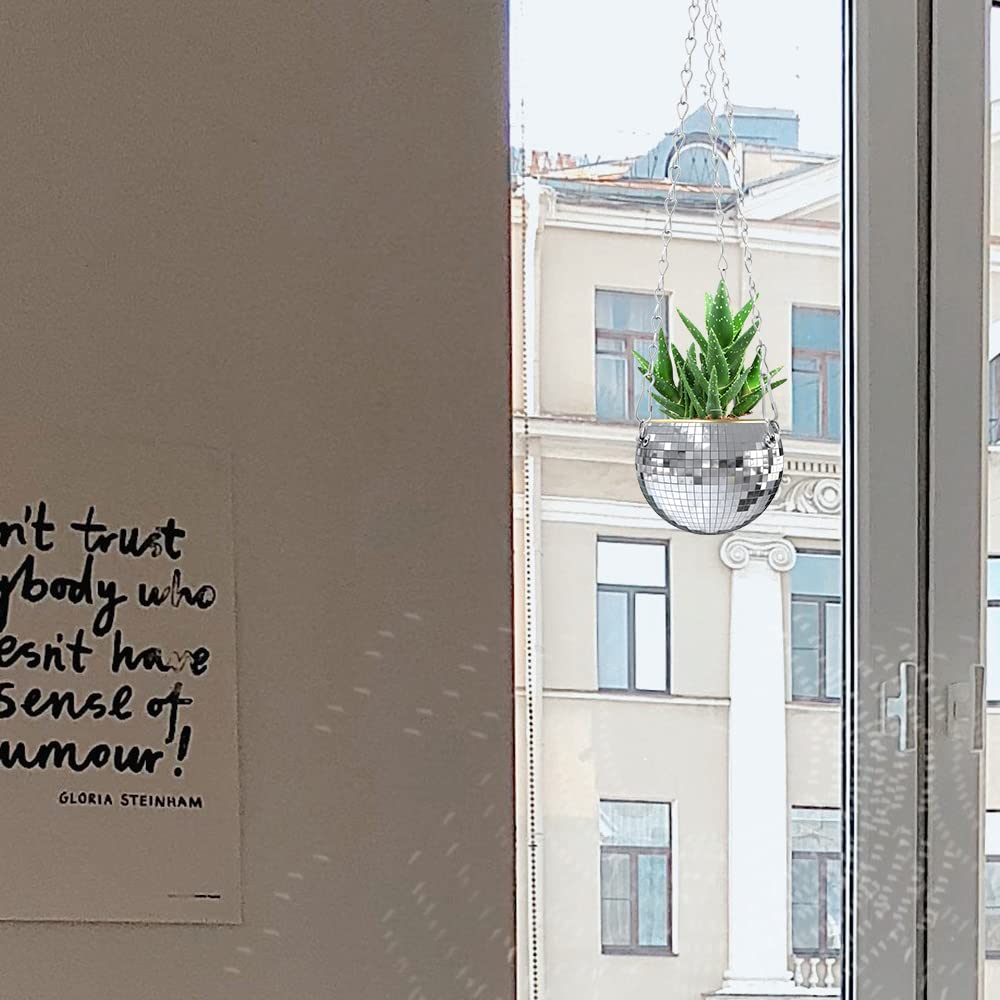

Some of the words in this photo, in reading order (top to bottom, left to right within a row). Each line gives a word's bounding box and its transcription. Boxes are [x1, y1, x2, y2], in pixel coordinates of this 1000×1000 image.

[71, 505, 186, 560] trust
[138, 568, 217, 610] who
[111, 629, 210, 676] have
[146, 681, 194, 745] of
[58, 791, 113, 806] GLORIA
[120, 793, 203, 809] STEINHAM
